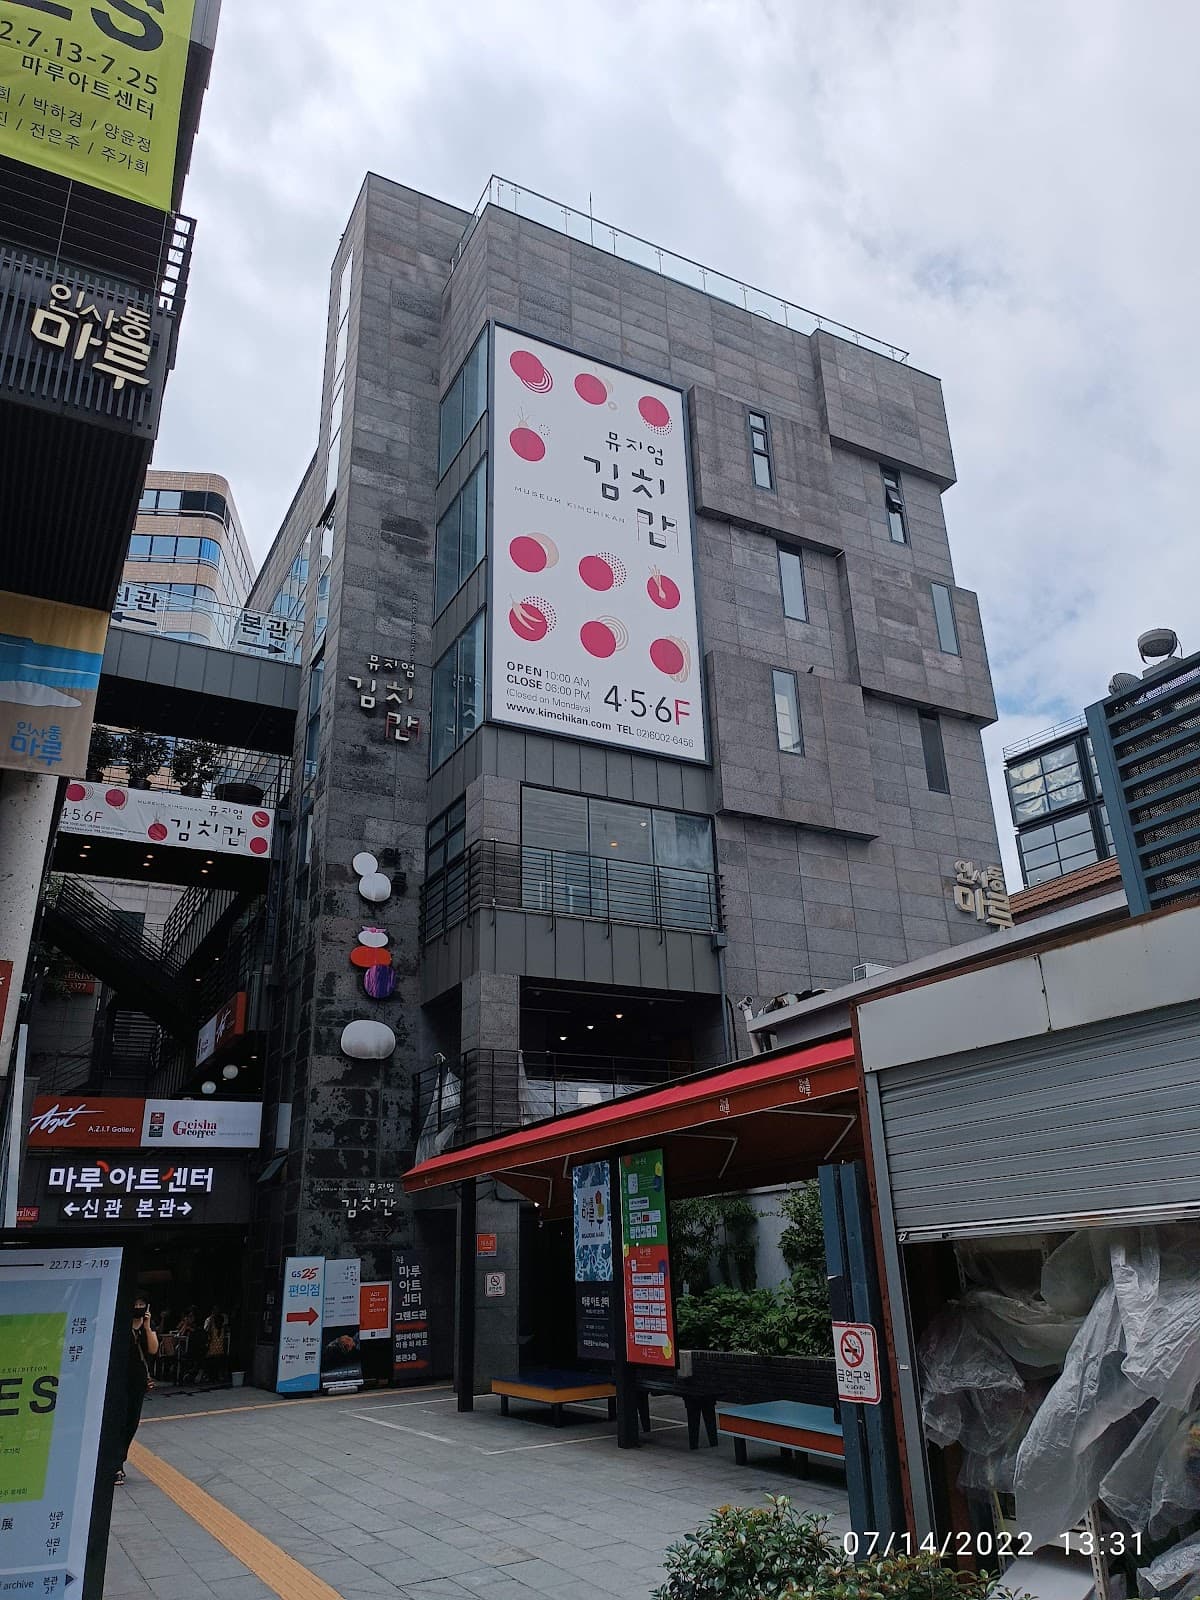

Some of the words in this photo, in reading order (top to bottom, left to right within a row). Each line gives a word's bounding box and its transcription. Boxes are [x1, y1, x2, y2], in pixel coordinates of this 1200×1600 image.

[22, 55, 154, 120] 마루아트센터
[33, 97, 83, 128] 박하경
[104, 122, 151, 153] 양윤정
[30, 122, 81, 150] 전은주
[101, 146, 150, 176] 주가희
[50, 283, 152, 340] 인사동
[30, 308, 152, 390] 마루
[605, 431, 664, 467] 뮤지엄
[514, 485, 562, 504] MUSEUM
[241, 612, 290, 642] 본관
[367, 654, 415, 678] 뮤지엄
[506, 661, 542, 677] OPEN
[544, 670, 571, 684] 10:00
[573, 675, 590, 688] AM
[506, 674, 543, 690] CLOSE
[574, 688, 590, 700] PM
[506, 701, 612, 731] www.kimchikan.com
[616, 723, 635, 737] TEL
[10, 735, 62, 766] 마루
[208, 805, 244, 821] 뮤지엄
[170, 818, 247, 848] 김치간
[953, 885, 1015, 931] 마루
[172, 1119, 217, 1136] Geisha
[49, 1161, 214, 1193] 마루아트센터
[368, 1182, 395, 1194] 뮤지엄
[82, 1199, 123, 1219] 신관
[136, 1199, 176, 1219] 본관
[341, 1197, 398, 1218] 김치간
[91, 1259, 110, 1268] 7.19
[291, 1267, 319, 1280] GS25
[398, 1265, 422, 1279] 마루
[288, 1282, 320, 1298] 편의점
[399, 1279, 423, 1293] 아트
[401, 1293, 422, 1307] 센터
[48, 1510, 64, 1521] 신관
[50, 1521, 60, 1530] 2F
[45, 1537, 61, 1548] 신관
[4, 1579, 34, 1590] archive
